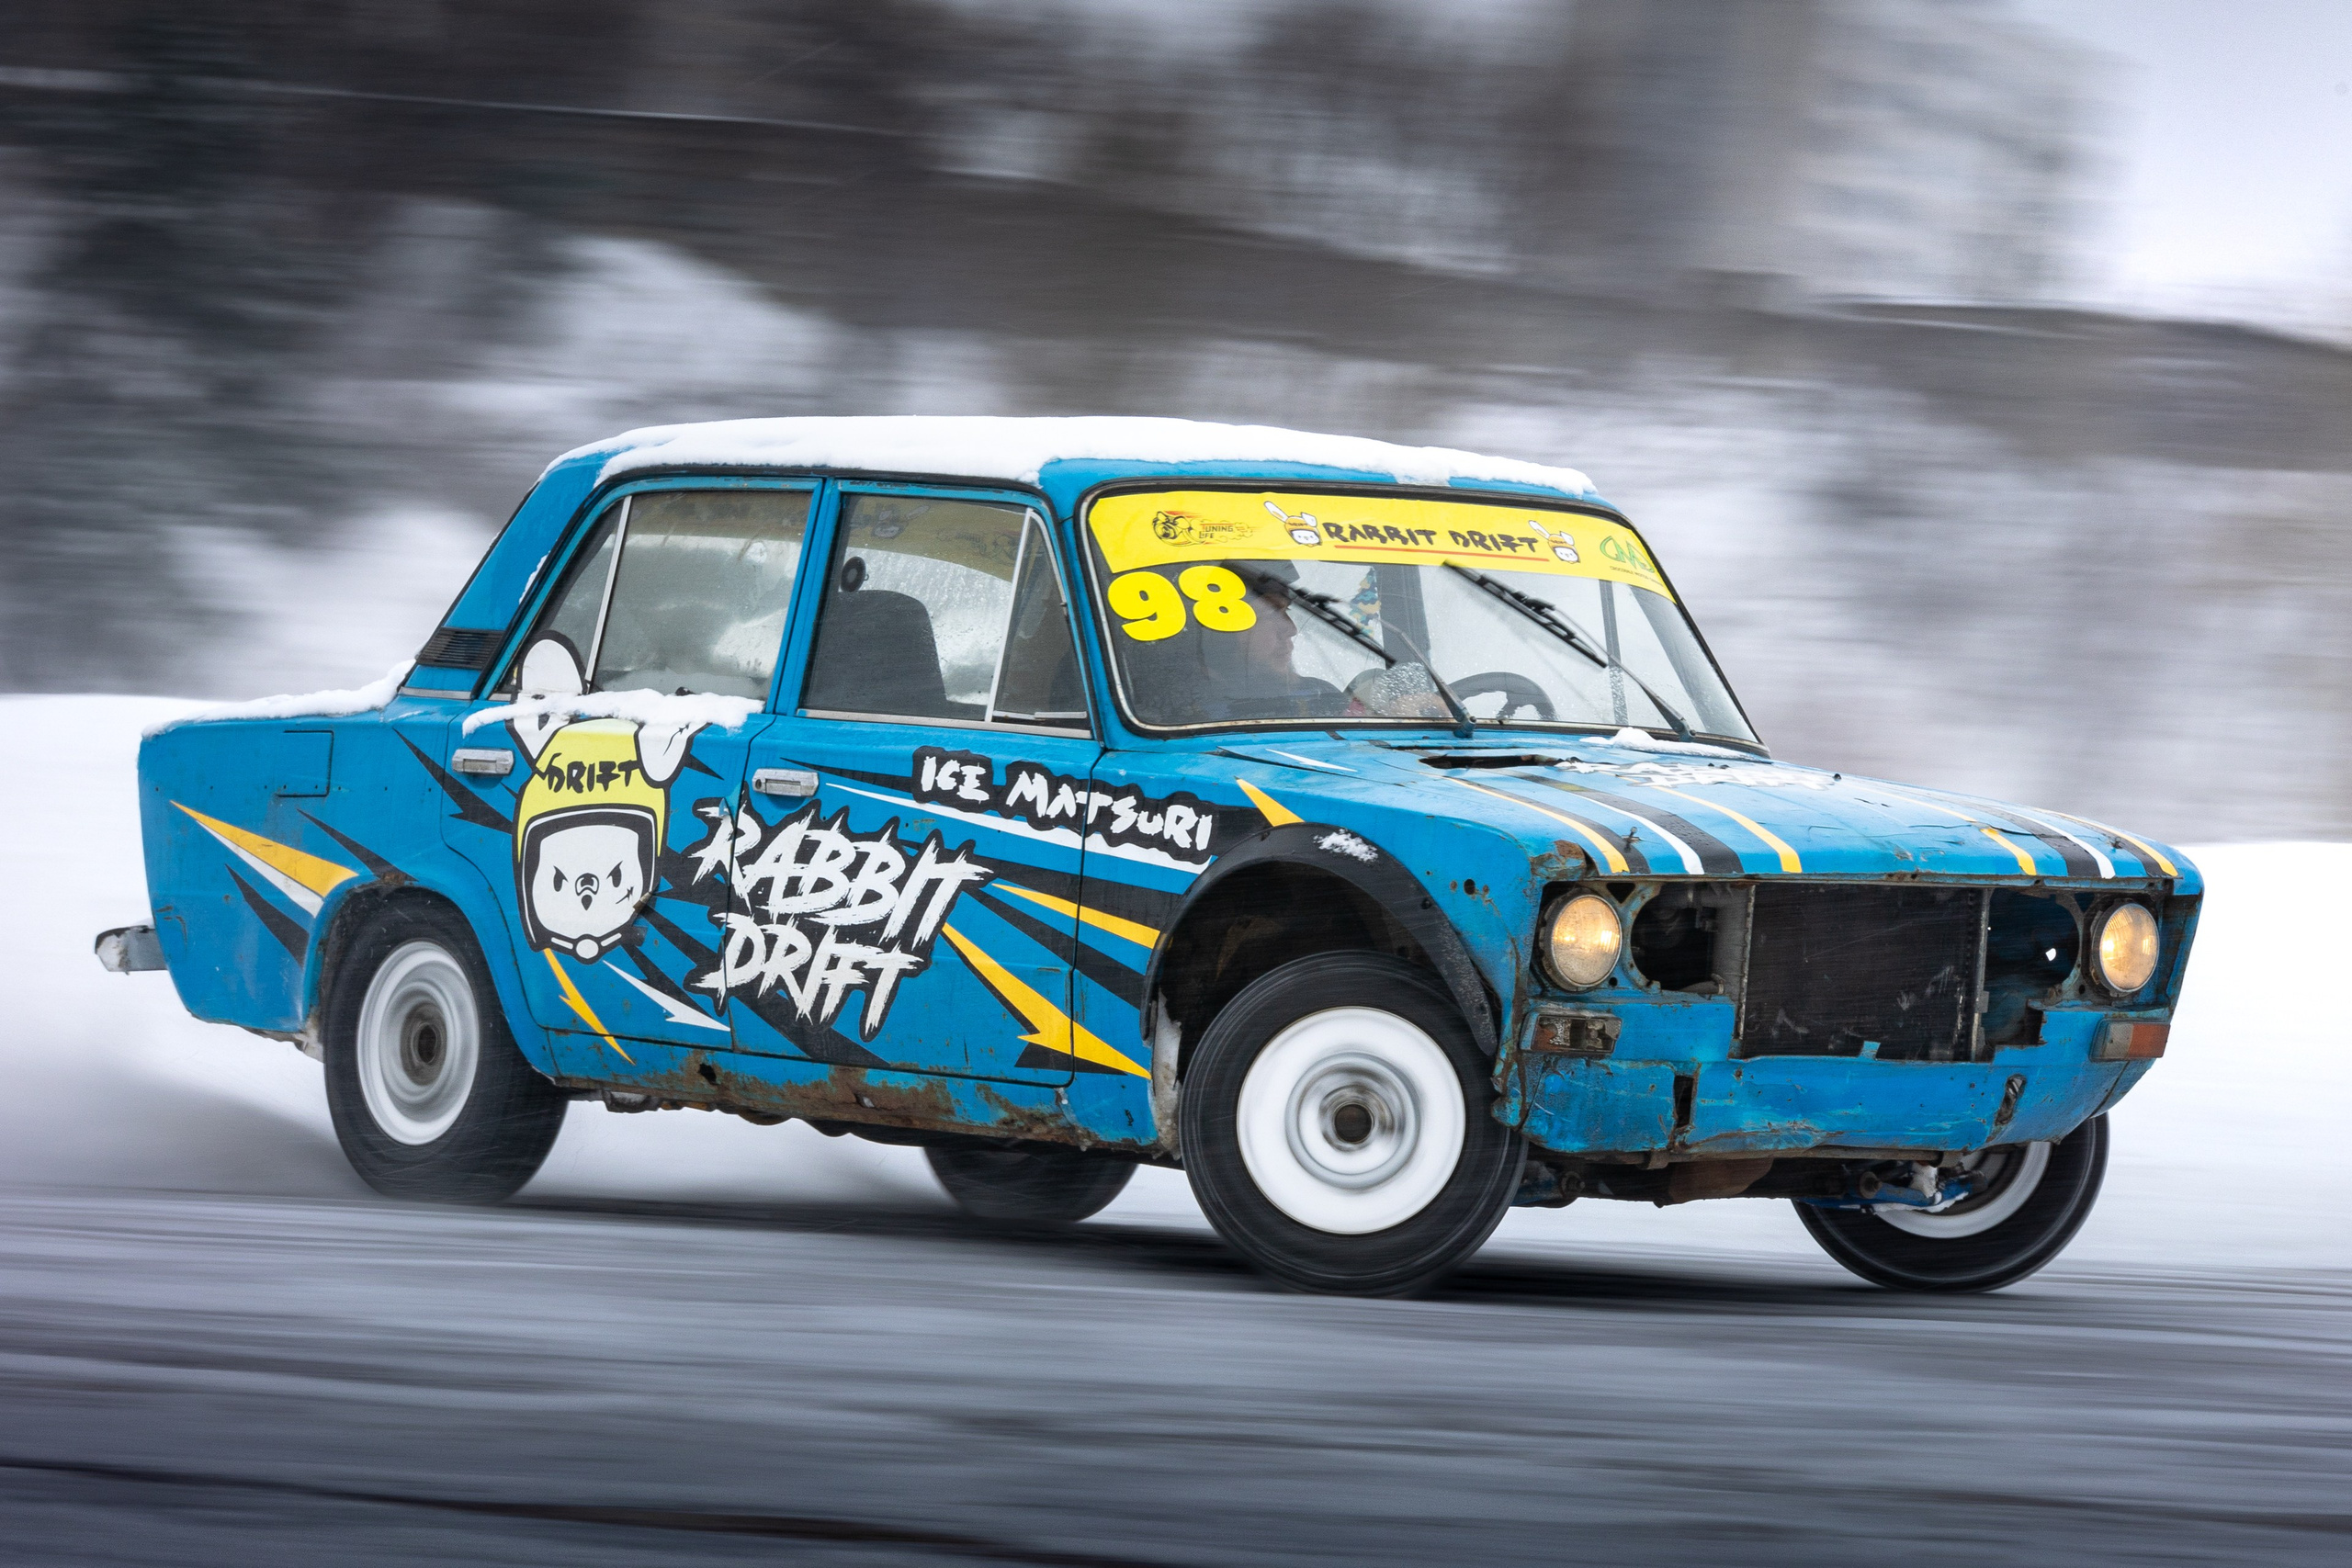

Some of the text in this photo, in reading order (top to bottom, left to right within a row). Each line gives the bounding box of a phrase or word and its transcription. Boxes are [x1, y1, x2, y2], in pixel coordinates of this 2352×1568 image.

[1323, 522, 1539, 553] RABBIT DRIFT
[1107, 565, 1257, 641] 98
[542, 752, 640, 793] DRIFT
[921, 756, 1213, 850] ICE MATSURI
[687, 790, 994, 951] RABBIT
[691, 912, 924, 1036] DRIFT
